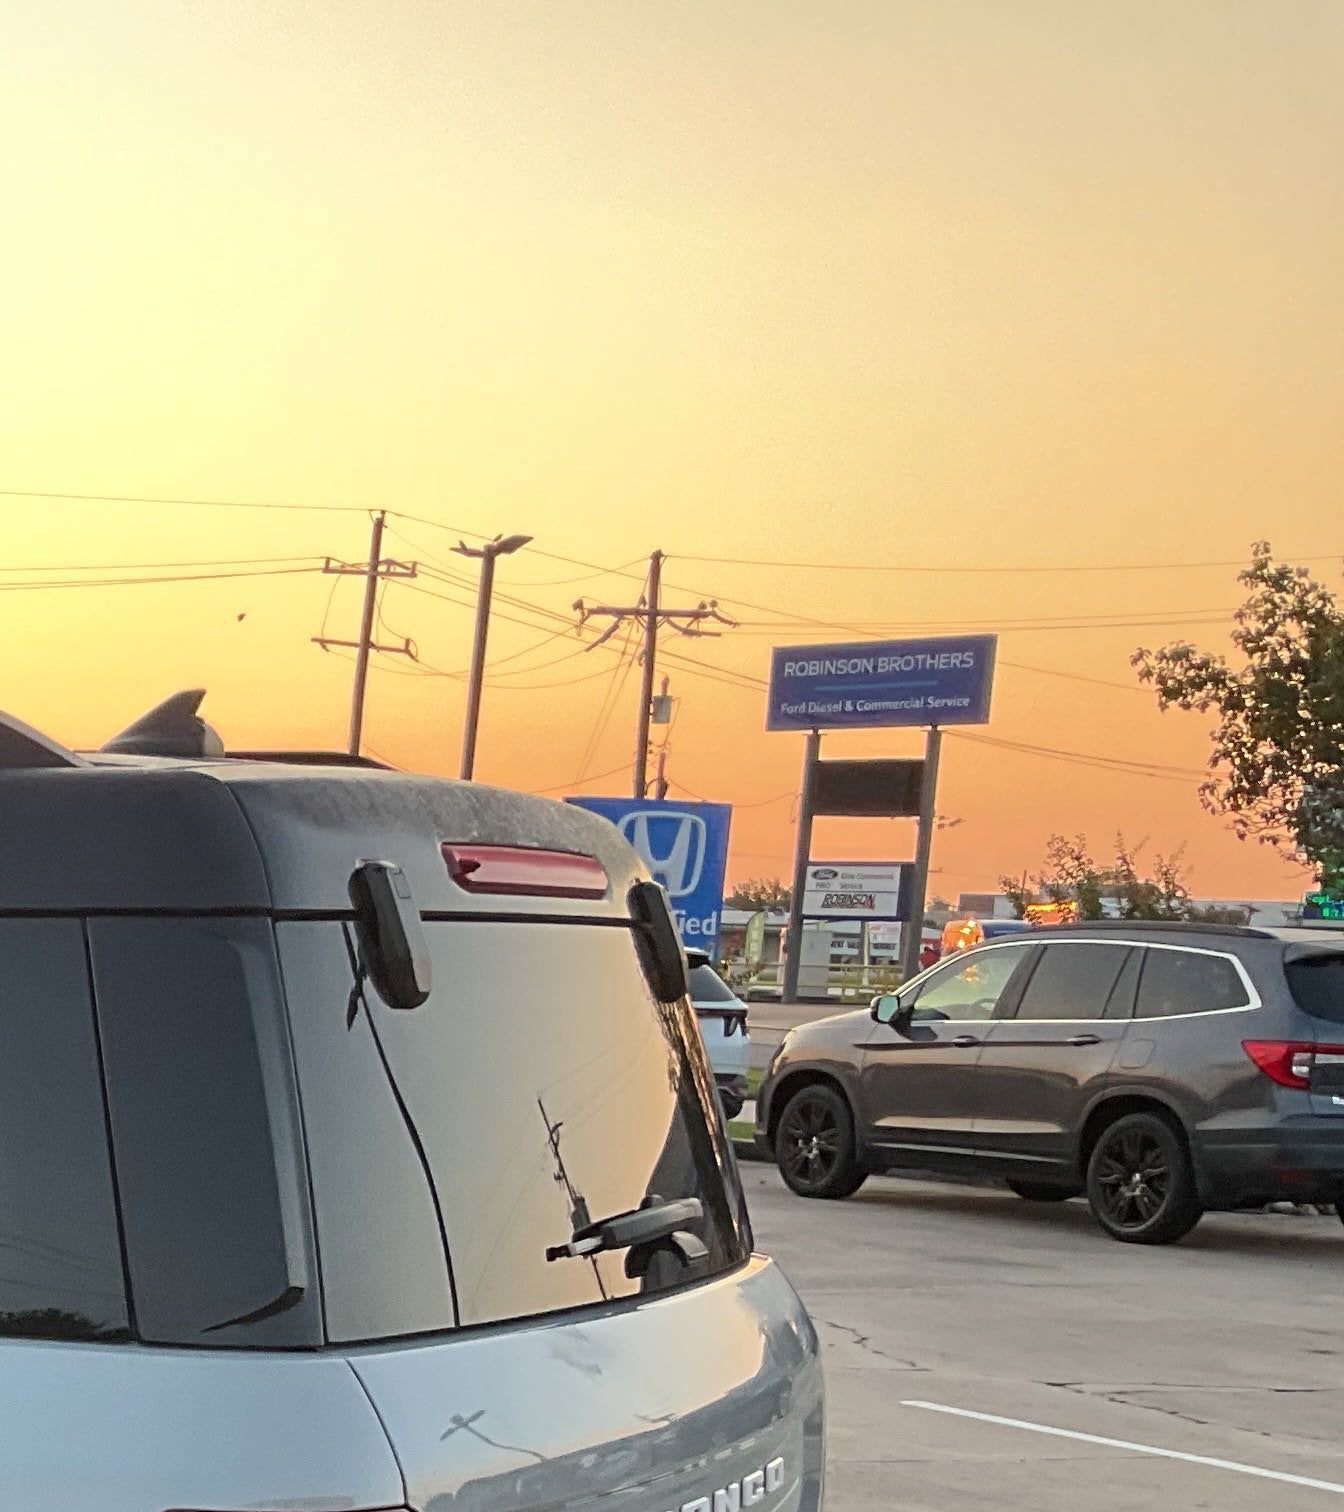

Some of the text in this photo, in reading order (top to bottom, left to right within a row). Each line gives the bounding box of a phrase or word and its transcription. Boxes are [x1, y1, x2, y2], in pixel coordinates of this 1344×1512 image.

[784, 652, 974, 677] ROBINSON BROTHERS
[781, 696, 970, 714] Ford Diesel & Commercial Service
